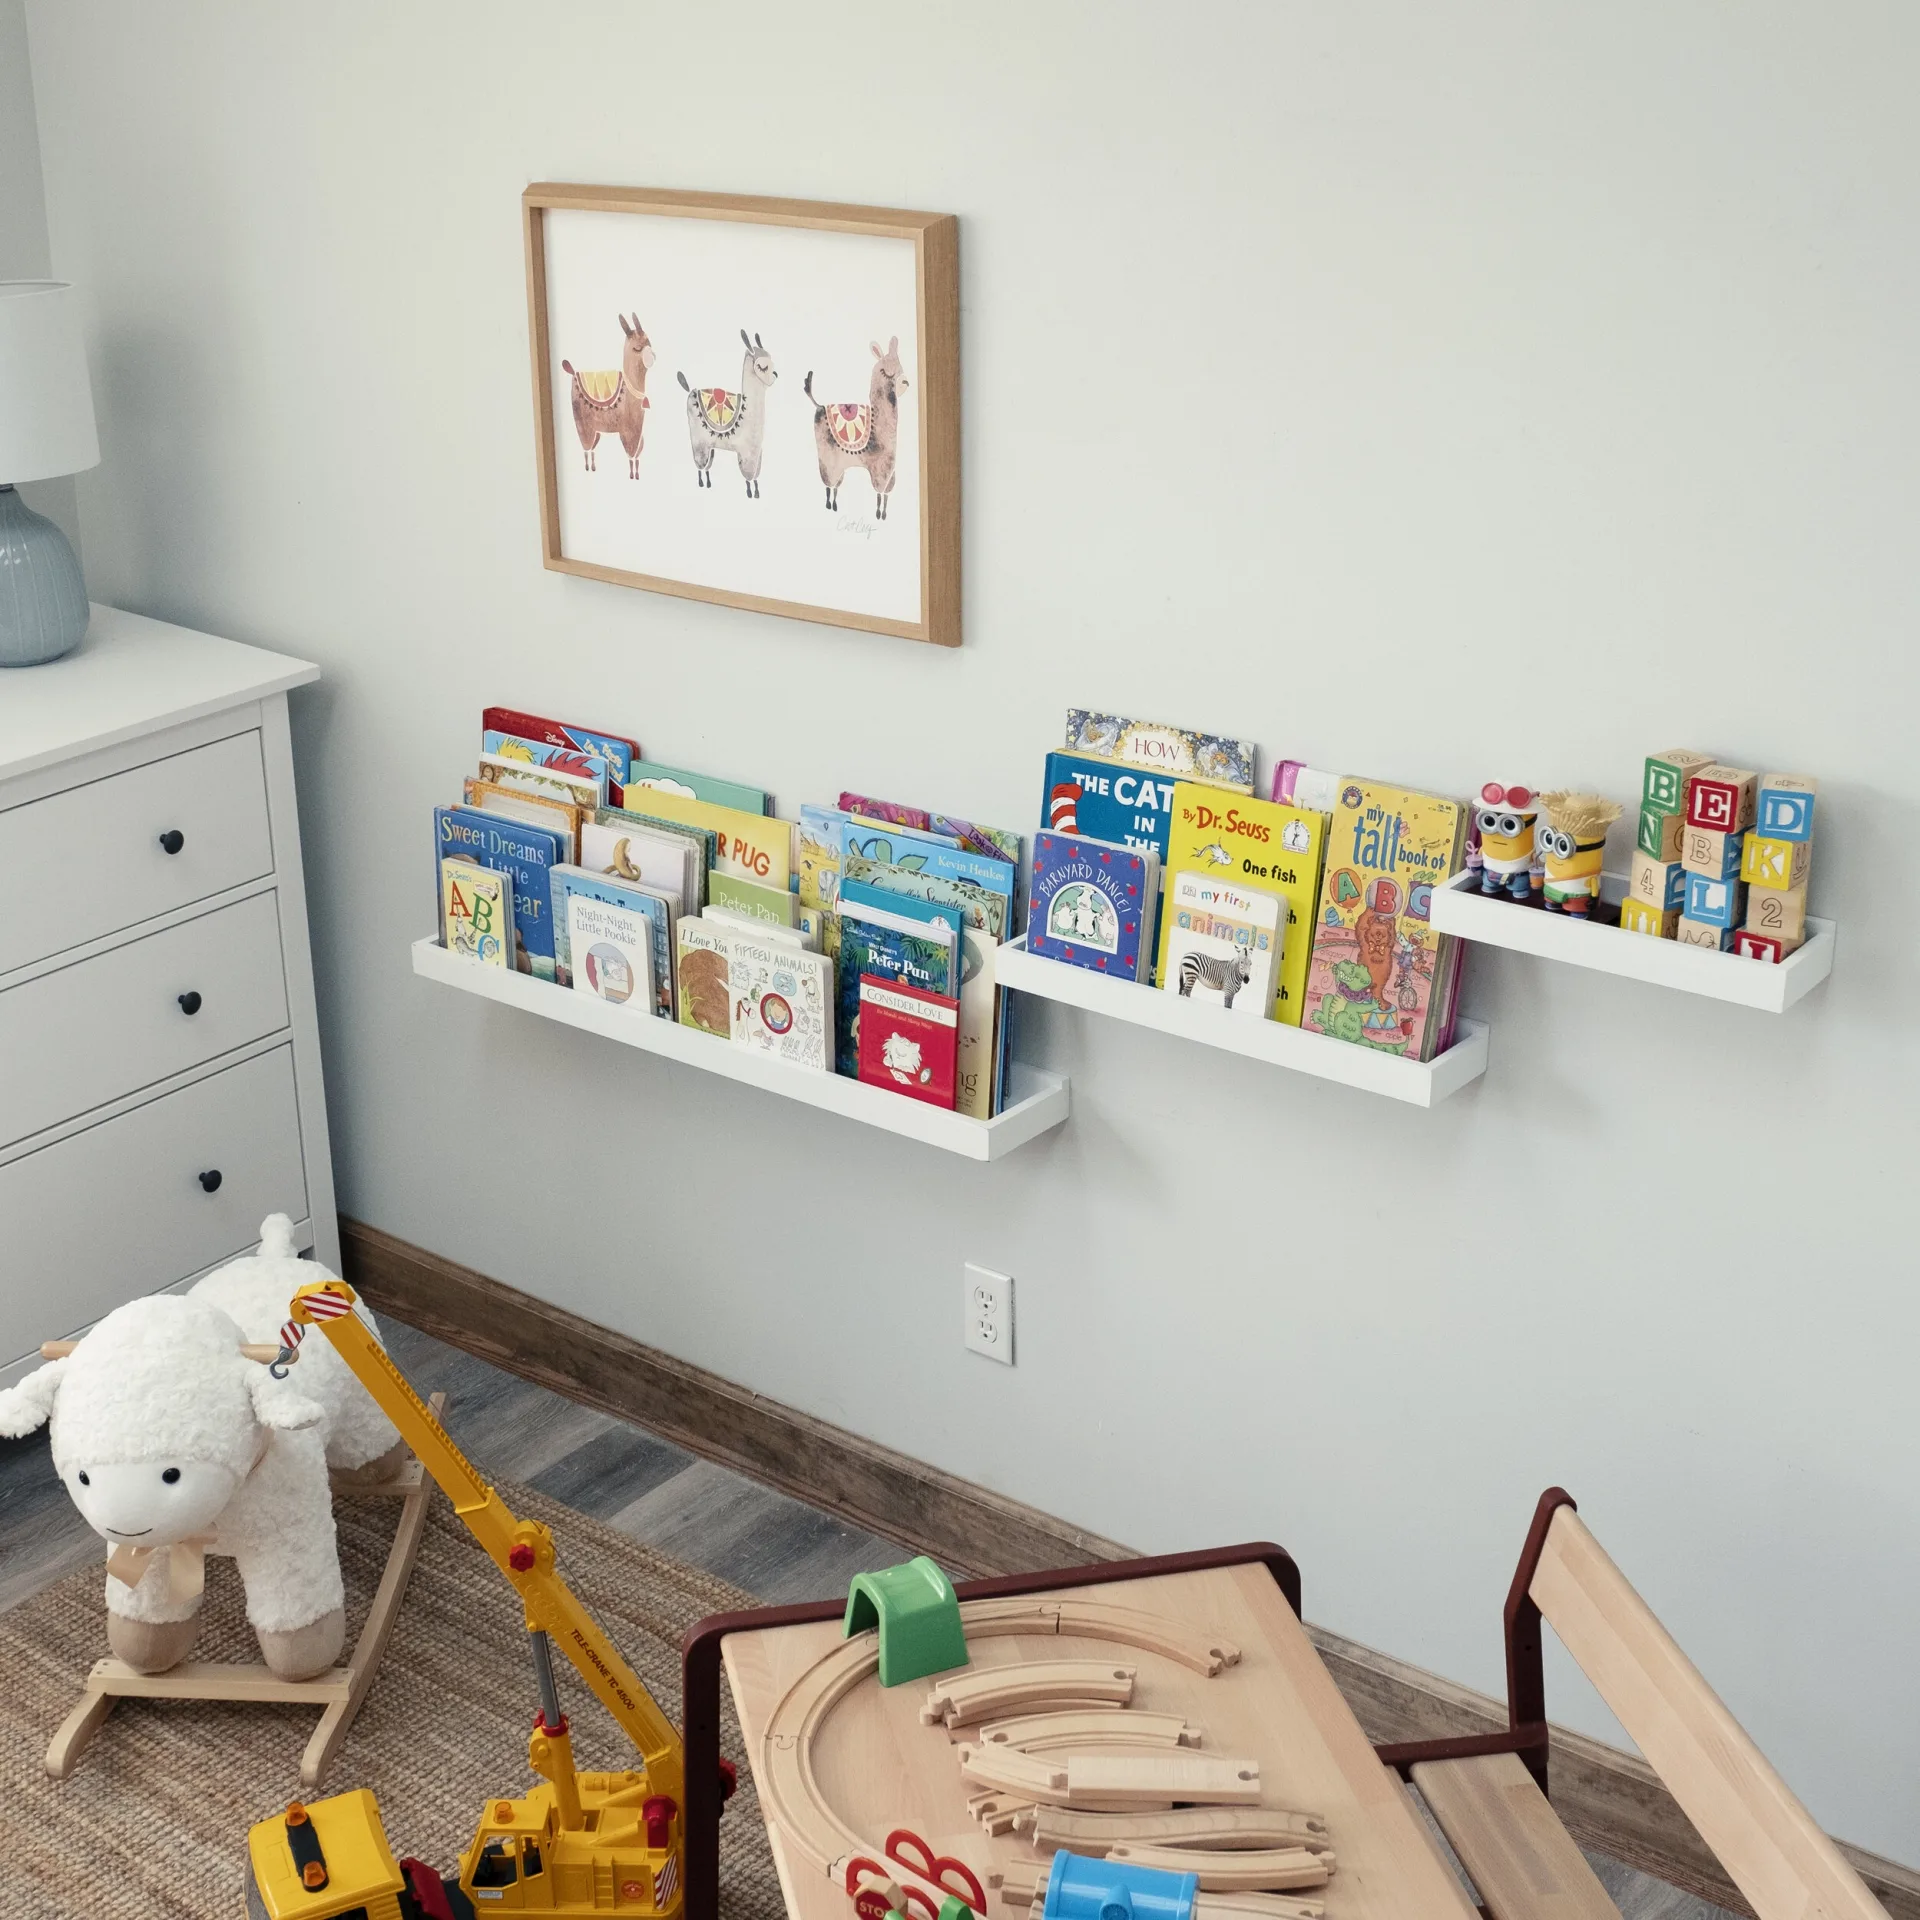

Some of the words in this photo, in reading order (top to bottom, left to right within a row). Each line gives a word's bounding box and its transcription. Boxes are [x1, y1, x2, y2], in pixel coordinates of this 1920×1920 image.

[1134, 737, 1180, 761] HOW
[1071, 772, 1110, 797] THE
[1113, 776, 1174, 813] CAT
[1696, 787, 1730, 823] E
[1133, 815, 1156, 833] IN
[1182, 807, 1197, 824] By
[1196, 805, 1223, 830] Dr.
[1225, 809, 1272, 843] Seuss
[1366, 807, 1385, 828] my
[1765, 797, 1803, 832] D
[441, 816, 487, 849] Sweet
[488, 830, 547, 868] Dreams,
[732, 838, 771, 877] PUG
[1353, 814, 1401, 873] tall
[1397, 844, 1428, 867] book
[938, 855, 966, 873] Kevin
[1242, 858, 1268, 878] One
[1271, 865, 1297, 885] fish
[1039, 863, 1093, 898] BARNYARD
[1096, 868, 1132, 914] DANCE!
[1201, 890, 1220, 904] my
[1224, 892, 1251, 911] first
[513, 893, 542, 919] ear
[719, 891, 753, 918] Peter
[756, 903, 780, 925] Pan
[1760, 897, 1783, 929] 2
[576, 919, 602, 936] Little
[604, 927, 637, 946] Pookie
[688, 931, 711, 949] Love
[1177, 911, 1268, 951] animals
[734, 943, 771, 963] FIFTEEN
[774, 954, 818, 976] ANIMALS!
[867, 948, 902, 972] Peter
[903, 960, 930, 981] Pan
[866, 988, 915, 1013] CONSIDER
[917, 1002, 944, 1021] LOVE
[570, 1628, 611, 1679] TELE-CRANE
[606, 1674, 619, 1690] TC
[859, 1901, 885, 1918] STO
